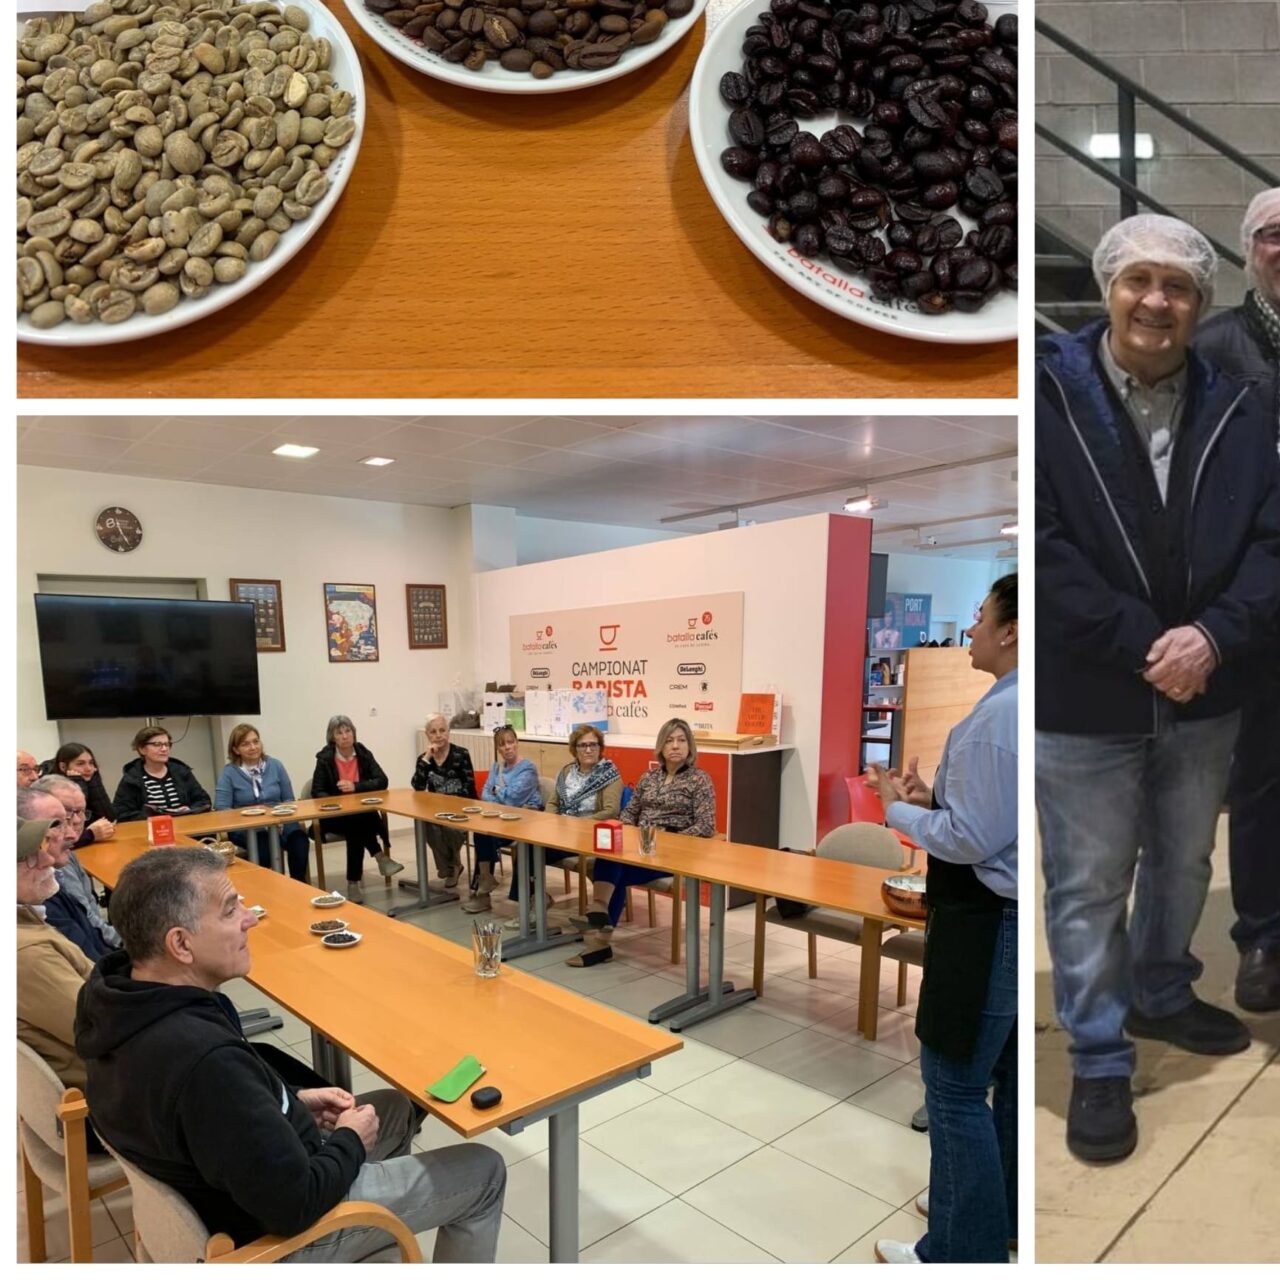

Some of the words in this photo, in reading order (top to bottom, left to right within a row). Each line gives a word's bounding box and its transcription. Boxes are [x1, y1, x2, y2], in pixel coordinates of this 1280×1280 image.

[905, 599, 923, 611] PORT
[696, 629, 718, 641] cafés
[572, 659, 648, 677] CAMPIONAT
[616, 700, 648, 718] cafés
